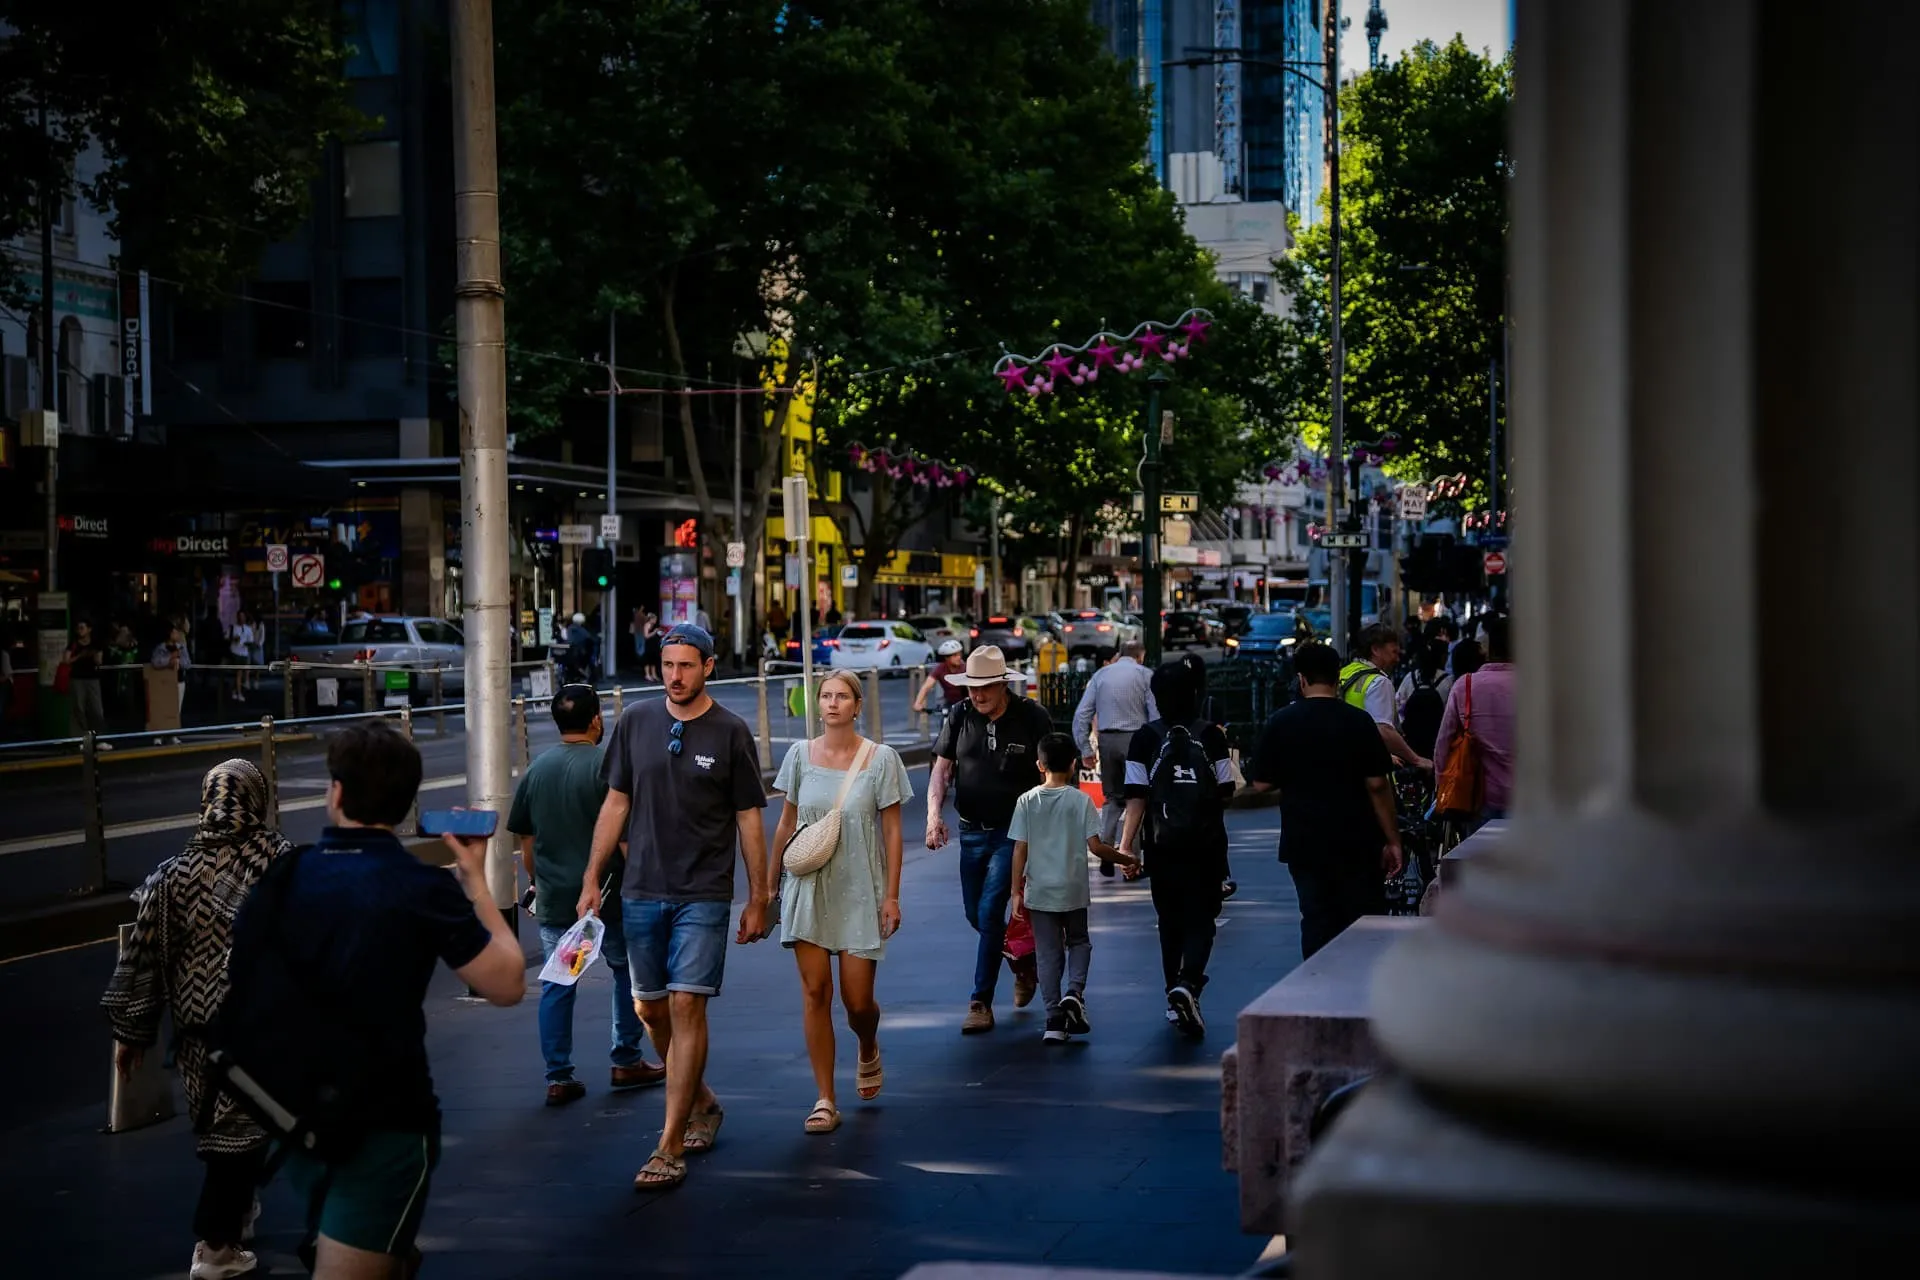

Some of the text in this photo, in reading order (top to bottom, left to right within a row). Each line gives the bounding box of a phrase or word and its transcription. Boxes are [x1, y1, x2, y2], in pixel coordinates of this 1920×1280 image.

[1406, 488, 1423, 497] ONE
[1163, 496, 1190, 509] EN
[1404, 499, 1423, 508] WAY
